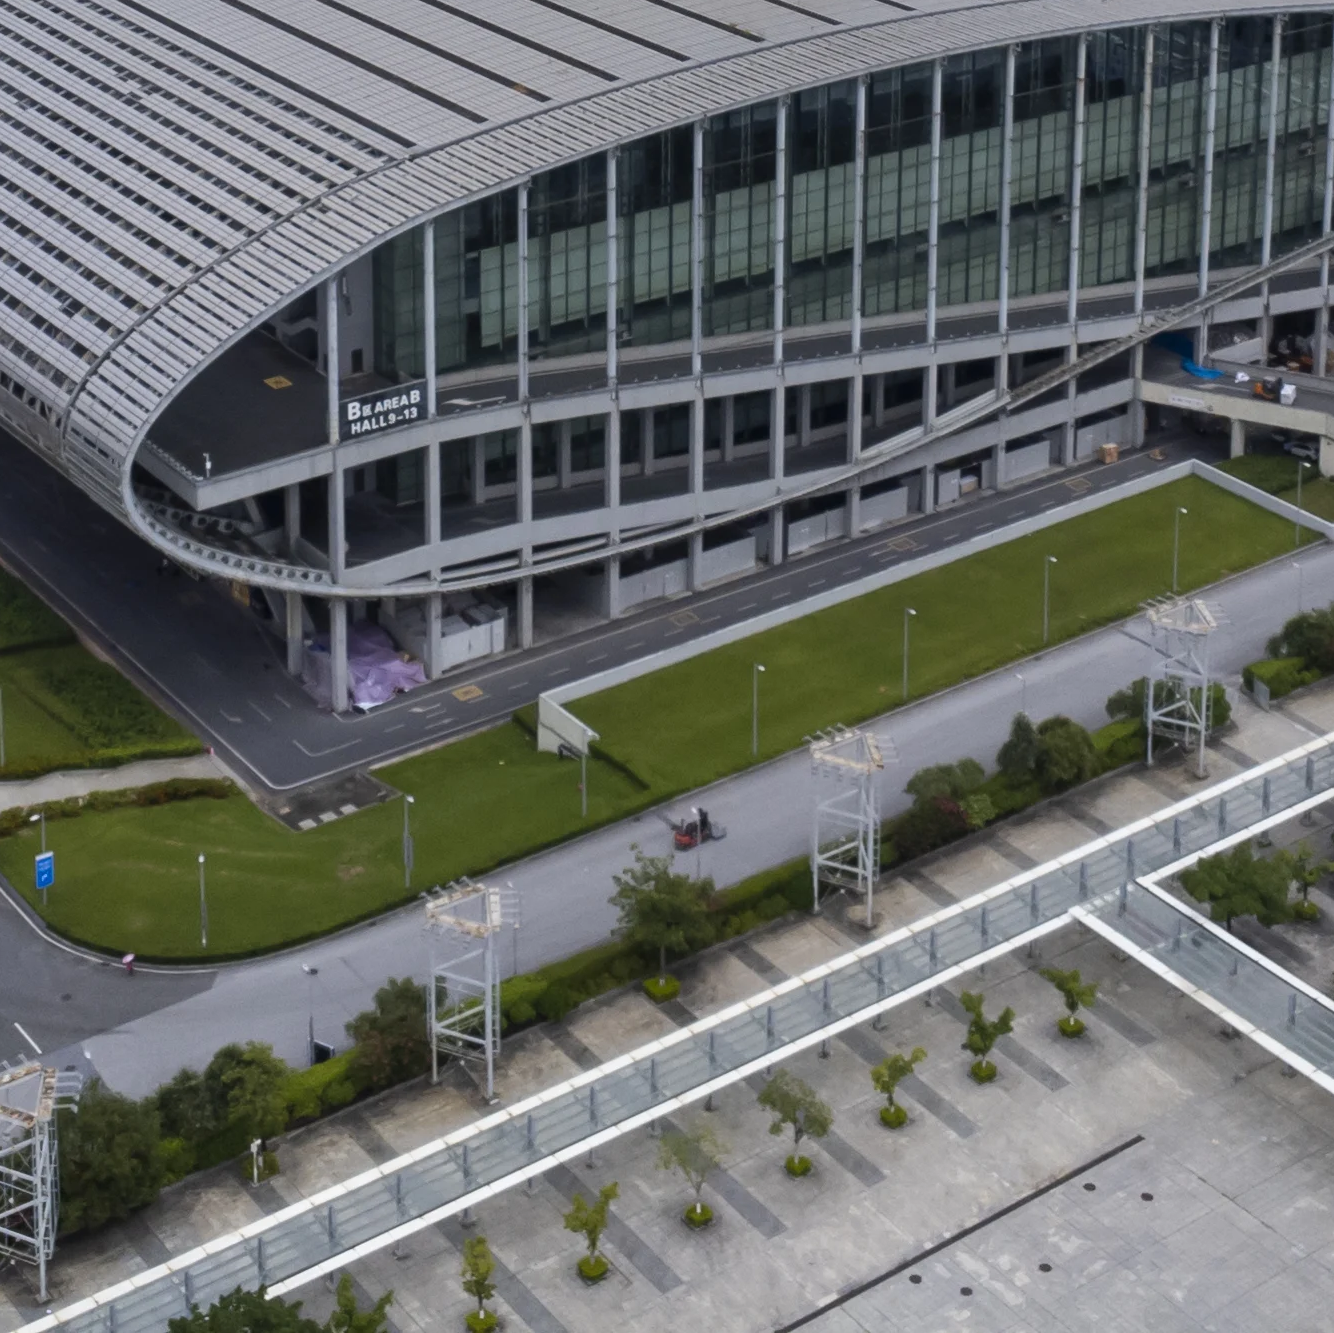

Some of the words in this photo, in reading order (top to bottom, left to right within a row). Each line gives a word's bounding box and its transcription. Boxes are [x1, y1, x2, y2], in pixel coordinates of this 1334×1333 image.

[373, 398, 407, 415] AREA
[409, 389, 421, 405] B
[350, 414, 387, 435] HALL
[387, 407, 418, 424] 9-13
